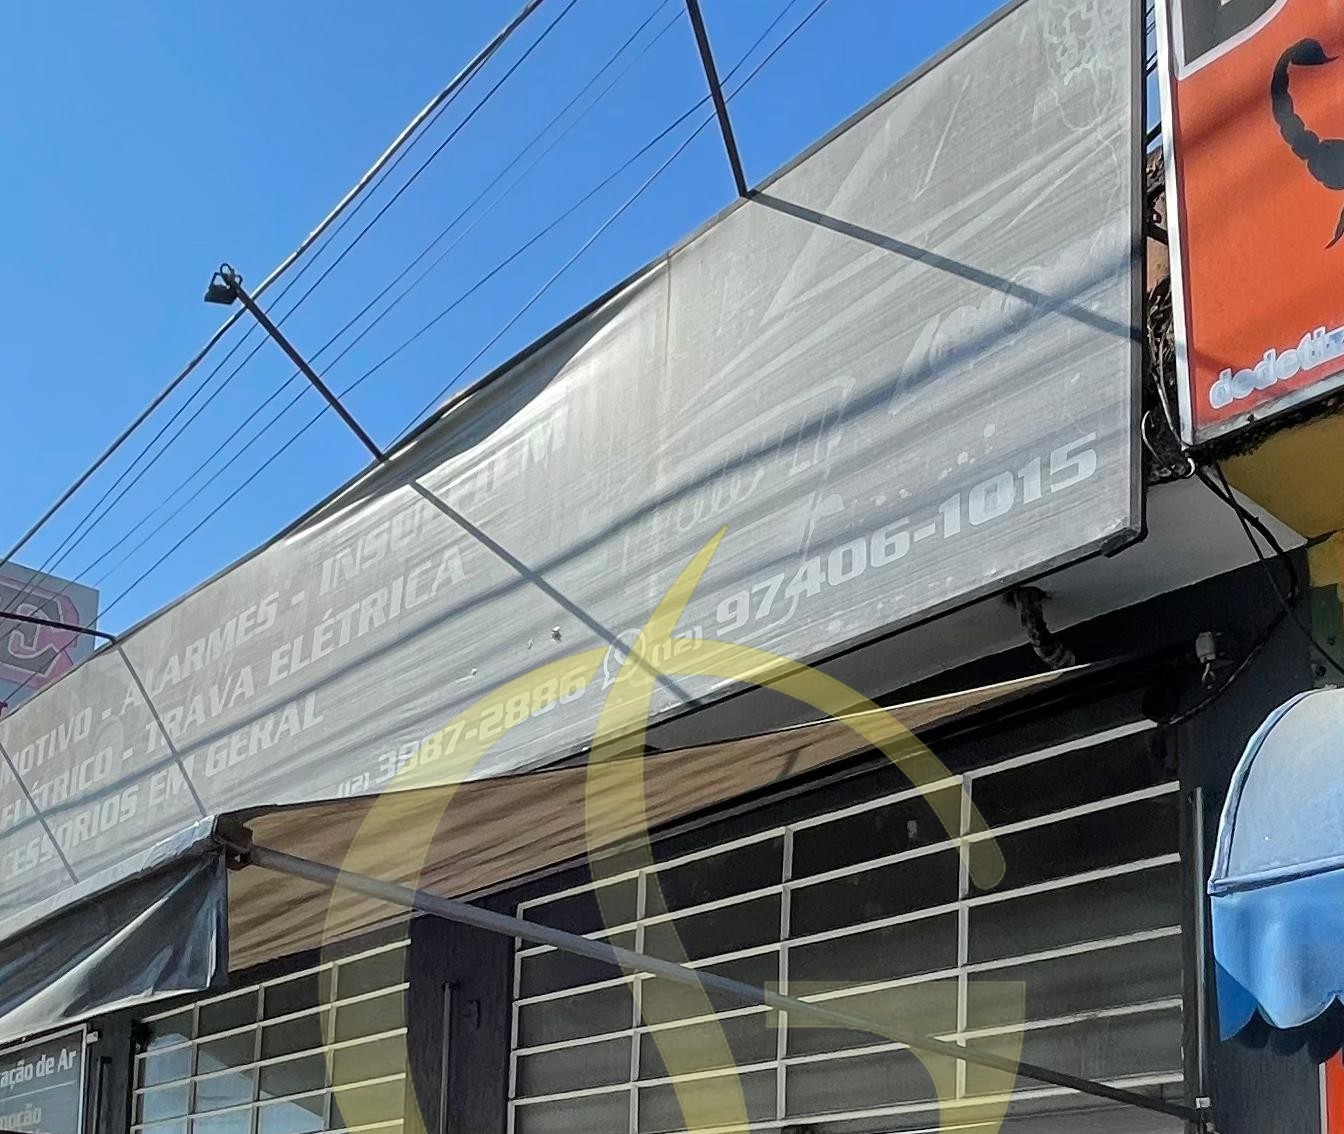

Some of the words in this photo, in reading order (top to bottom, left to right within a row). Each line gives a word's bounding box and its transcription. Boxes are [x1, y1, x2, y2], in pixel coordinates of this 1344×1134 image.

[715, 432, 1098, 637] 97406-1015
[267, 548, 467, 688] ELÉTRICA
[205, 692, 326, 778] GERAL
[35, 1054, 55, 1078] de
[57, 1048, 77, 1074] Ar
